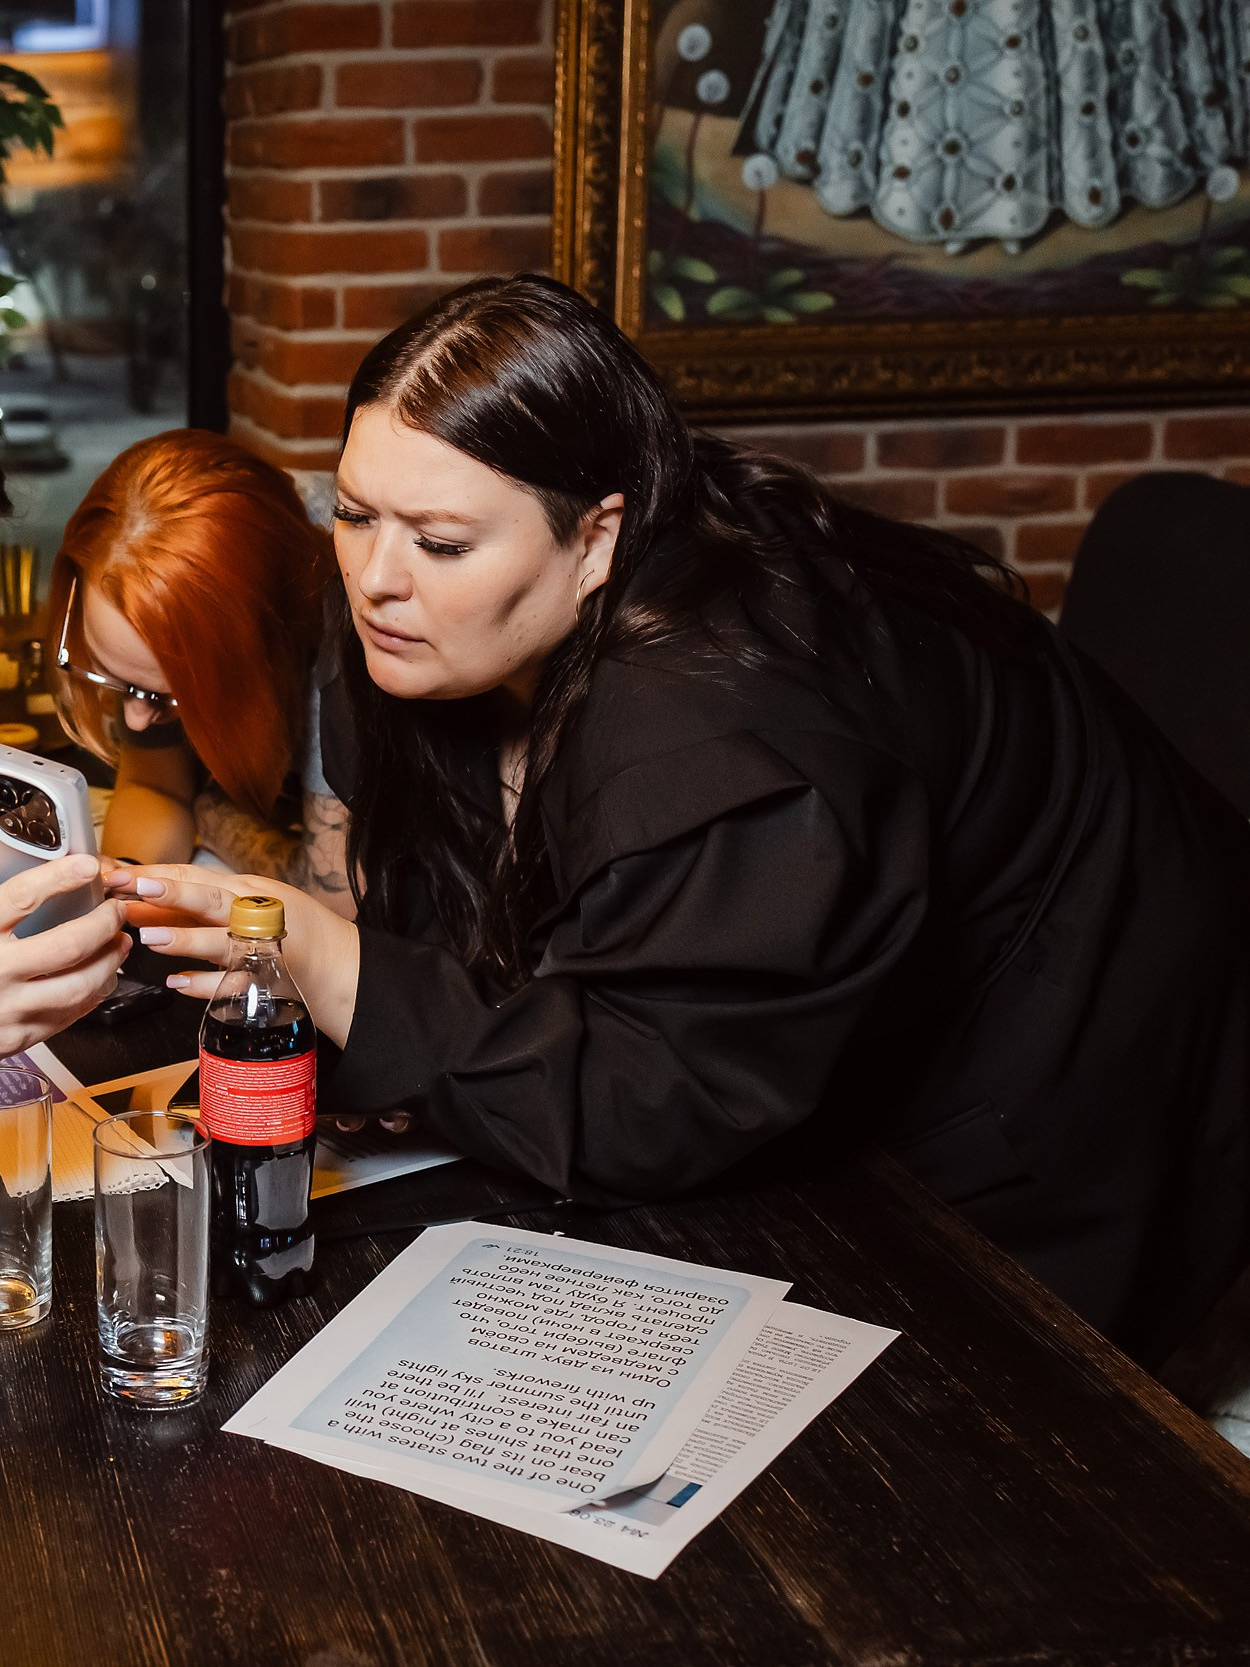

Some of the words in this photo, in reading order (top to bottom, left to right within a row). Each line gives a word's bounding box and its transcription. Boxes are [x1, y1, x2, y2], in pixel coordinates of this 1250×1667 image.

[506, 1246, 539, 1257] 18:21
[461, 1268, 525, 1285] вплоть
[497, 1264, 542, 1278] небо
[503, 1254, 640, 1289] фейерверками.
[449, 1276, 526, 1298] честный
[527, 1280, 564, 1295] там
[544, 1273, 610, 1293] летнее
[530, 1291, 566, 1306] под
[563, 1288, 609, 1305] буду
[610, 1287, 646, 1300] как
[642, 1283, 730, 1306] озарится
[451, 1298, 529, 1321] поведет
[475, 1292, 540, 1312] можно
[568, 1300, 627, 1318] вклад
[611, 1299, 628, 1309] Я
[650, 1294, 694, 1311] того,
[459, 1312, 490, 1325] что
[542, 1307, 576, 1319] где
[633, 1303, 716, 1326] процент.
[695, 1305, 725, 1316] до
[493, 1318, 538, 1336] того,
[531, 1315, 586, 1333] ночи)
[579, 1313, 638, 1332] город,
[630, 1314, 709, 1335] сделать
[470, 1326, 530, 1345] своём
[588, 1328, 602, 1336] в
[640, 1327, 654, 1336] в
[657, 1331, 700, 1346] тебя
[467, 1338, 538, 1359] штатов
[533, 1340, 558, 1351] на
[542, 1330, 623, 1355] (выбери
[603, 1331, 695, 1356] сверкает
[540, 1353, 590, 1369] двух
[561, 1346, 664, 1373] медведем
[626, 1348, 687, 1367] флаге
[397, 1359, 449, 1378] lights
[590, 1364, 615, 1375] из
[666, 1368, 680, 1376] с
[379, 1380, 400, 1390] at
[386, 1369, 434, 1387] there
[450, 1370, 484, 1385] sky
[493, 1368, 582, 1395] fireworks.
[618, 1370, 672, 1388] Один
[436, 1381, 462, 1394] be
[462, 1387, 486, 1399] I'll
[485, 1380, 566, 1402] summer
[344, 1397, 377, 1411] will
[361, 1389, 399, 1403] you
[402, 1386, 516, 1417] contribution
[585, 1388, 626, 1404] with
[631, 1398, 656, 1410] up
[398, 1398, 455, 1418] where
[497, 1394, 574, 1419] interest.
[569, 1397, 600, 1412] the
[344, 1410, 375, 1425] the
[381, 1405, 438, 1426] night)
[458, 1411, 495, 1426] city
[519, 1412, 533, 1421] a
[575, 1413, 610, 1428] fair
[603, 1405, 648, 1422] until
[327, 1419, 340, 1428] a
[343, 1423, 383, 1440] with
[439, 1421, 461, 1432] at
[498, 1421, 512, 1430] a
[515, 1425, 536, 1437] to
[535, 1416, 591, 1435] make
[615, 1421, 641, 1433] an
[378, 1419, 455, 1446] (choose
[464, 1427, 529, 1448] shines
[539, 1431, 579, 1446] you
[595, 1430, 632, 1444] can
[387, 1435, 448, 1456] states
[458, 1438, 496, 1456] flag
[531, 1443, 572, 1460] that
[578, 1440, 624, 1459] lead
[451, 1452, 488, 1468] two
[500, 1450, 526, 1464] its
[530, 1457, 556, 1468] on
[576, 1454, 615, 1468] one
[492, 1462, 525, 1477] the
[526, 1471, 551, 1482] of
[559, 1464, 607, 1483] bear
[555, 1477, 597, 1494] One
